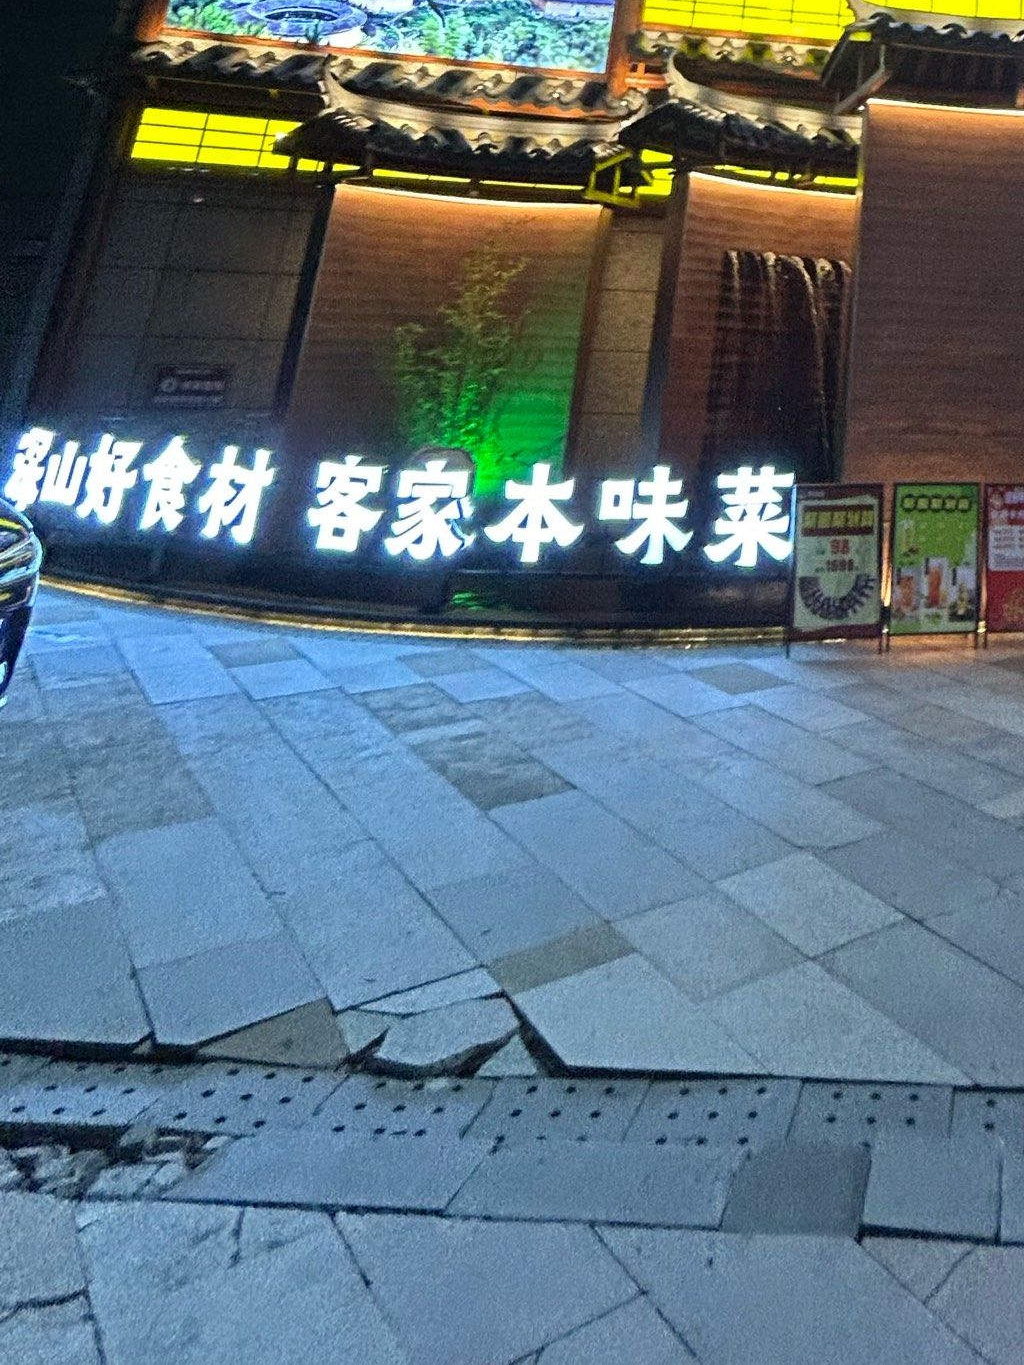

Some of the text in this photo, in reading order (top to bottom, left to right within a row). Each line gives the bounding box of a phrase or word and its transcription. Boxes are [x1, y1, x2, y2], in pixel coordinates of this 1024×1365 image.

[307, 455, 797, 567] 客家本味菜
